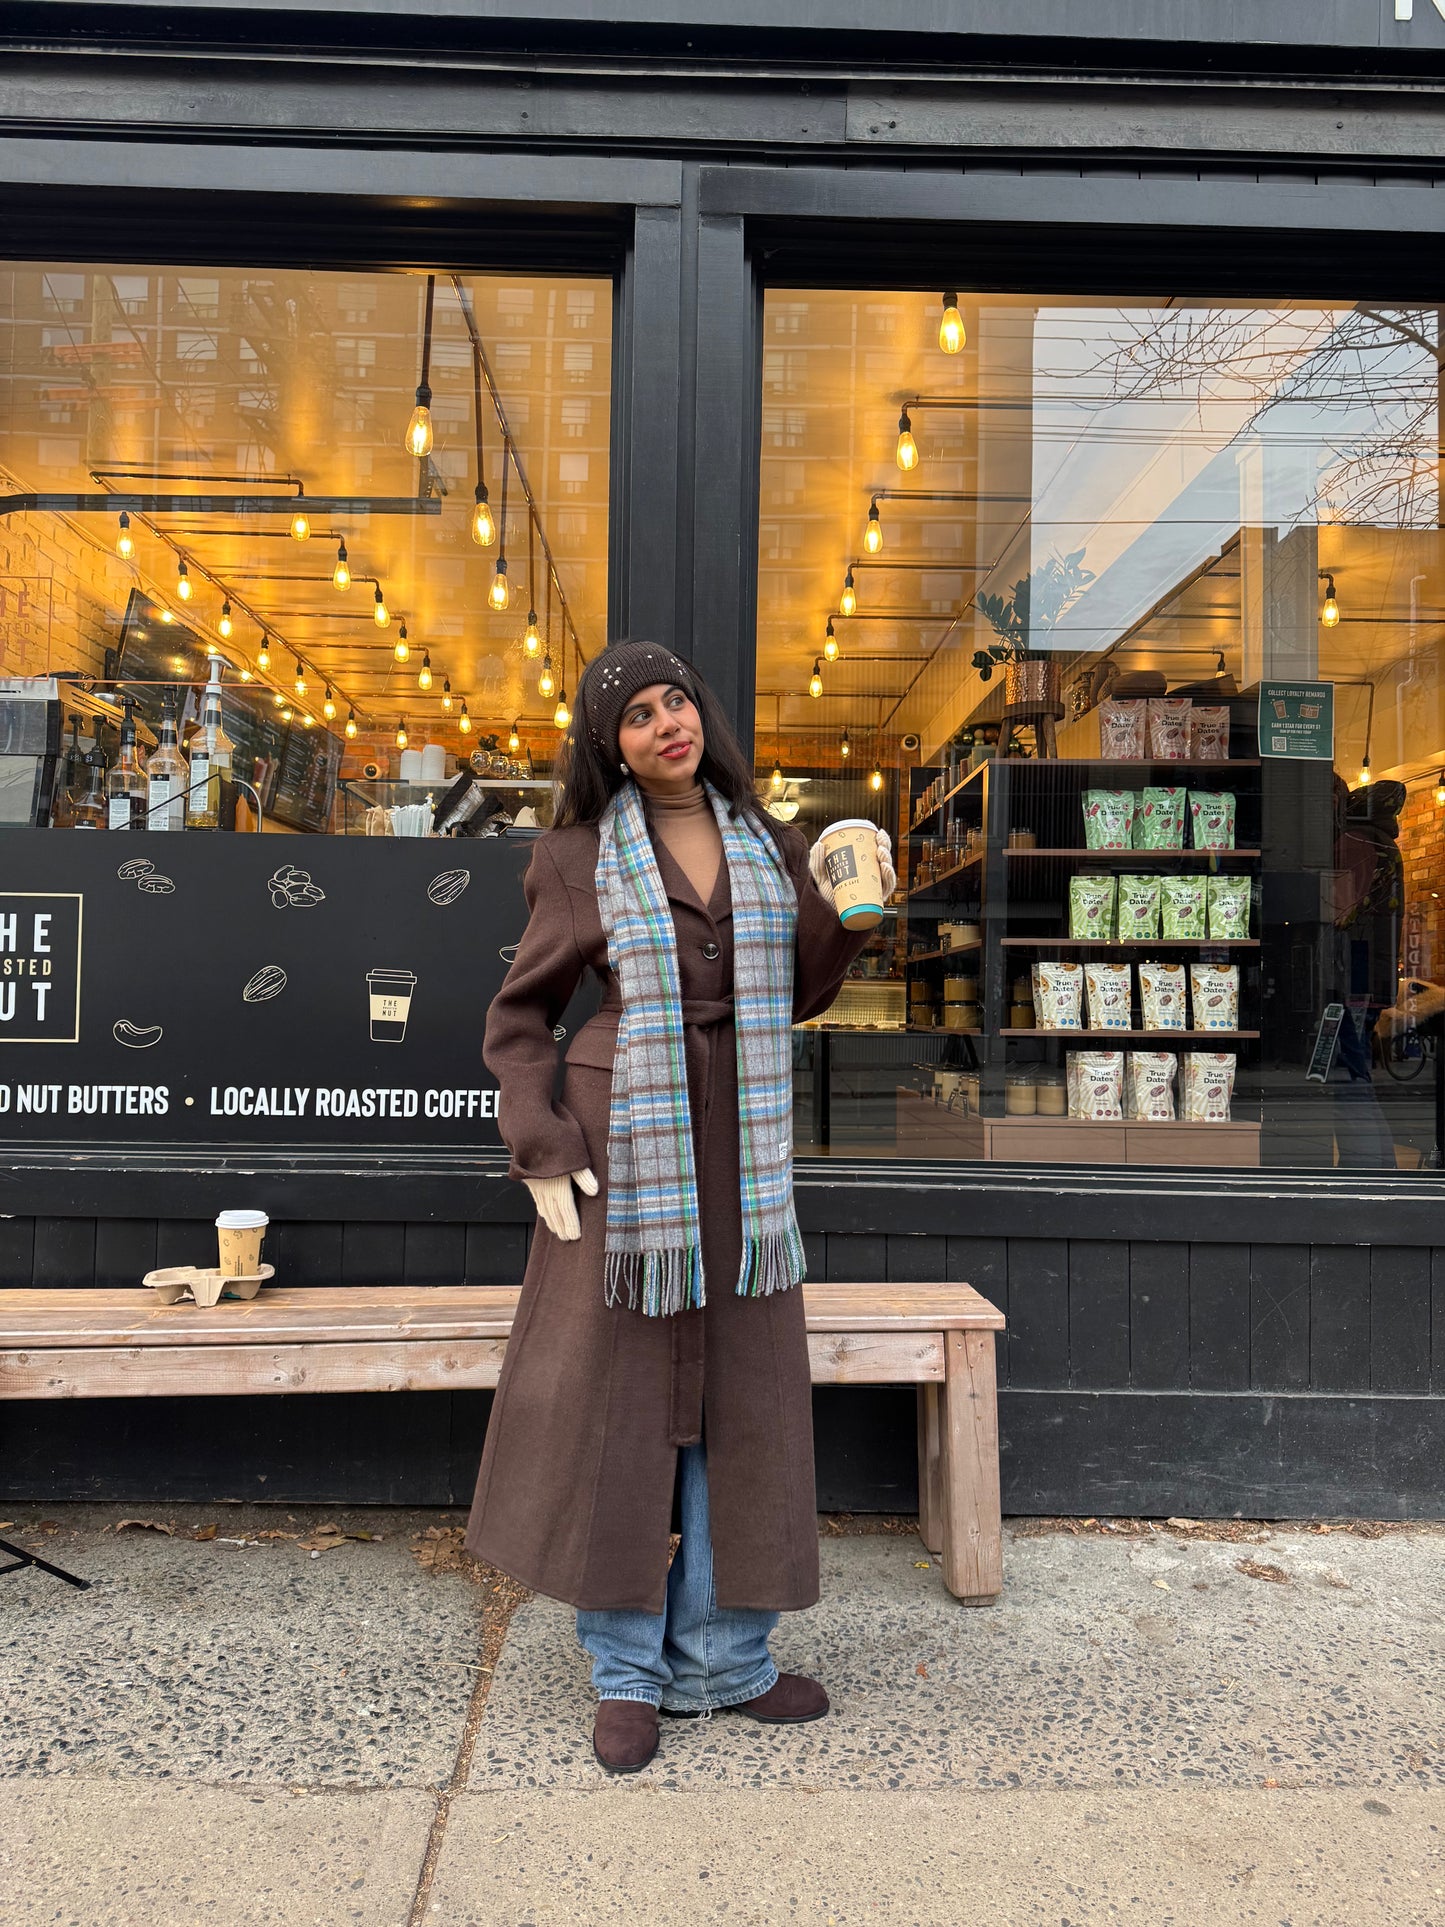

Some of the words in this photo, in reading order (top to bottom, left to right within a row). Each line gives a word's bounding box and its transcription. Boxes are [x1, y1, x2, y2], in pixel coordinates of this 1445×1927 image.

[827, 851, 847, 866] THE
[831, 866, 849, 882] NUT
[0, 913, 52, 953] HE
[3, 958, 52, 976] STED
[0, 981, 52, 1021] UT
[383, 999, 397, 1007] THE
[0, 1084, 11, 1113] D
[16, 1084, 63, 1114] NUT
[67, 1085, 170, 1115] BUTTERS
[210, 1086, 310, 1116] LOCALLY
[315, 1088, 419, 1118] ROASTED
